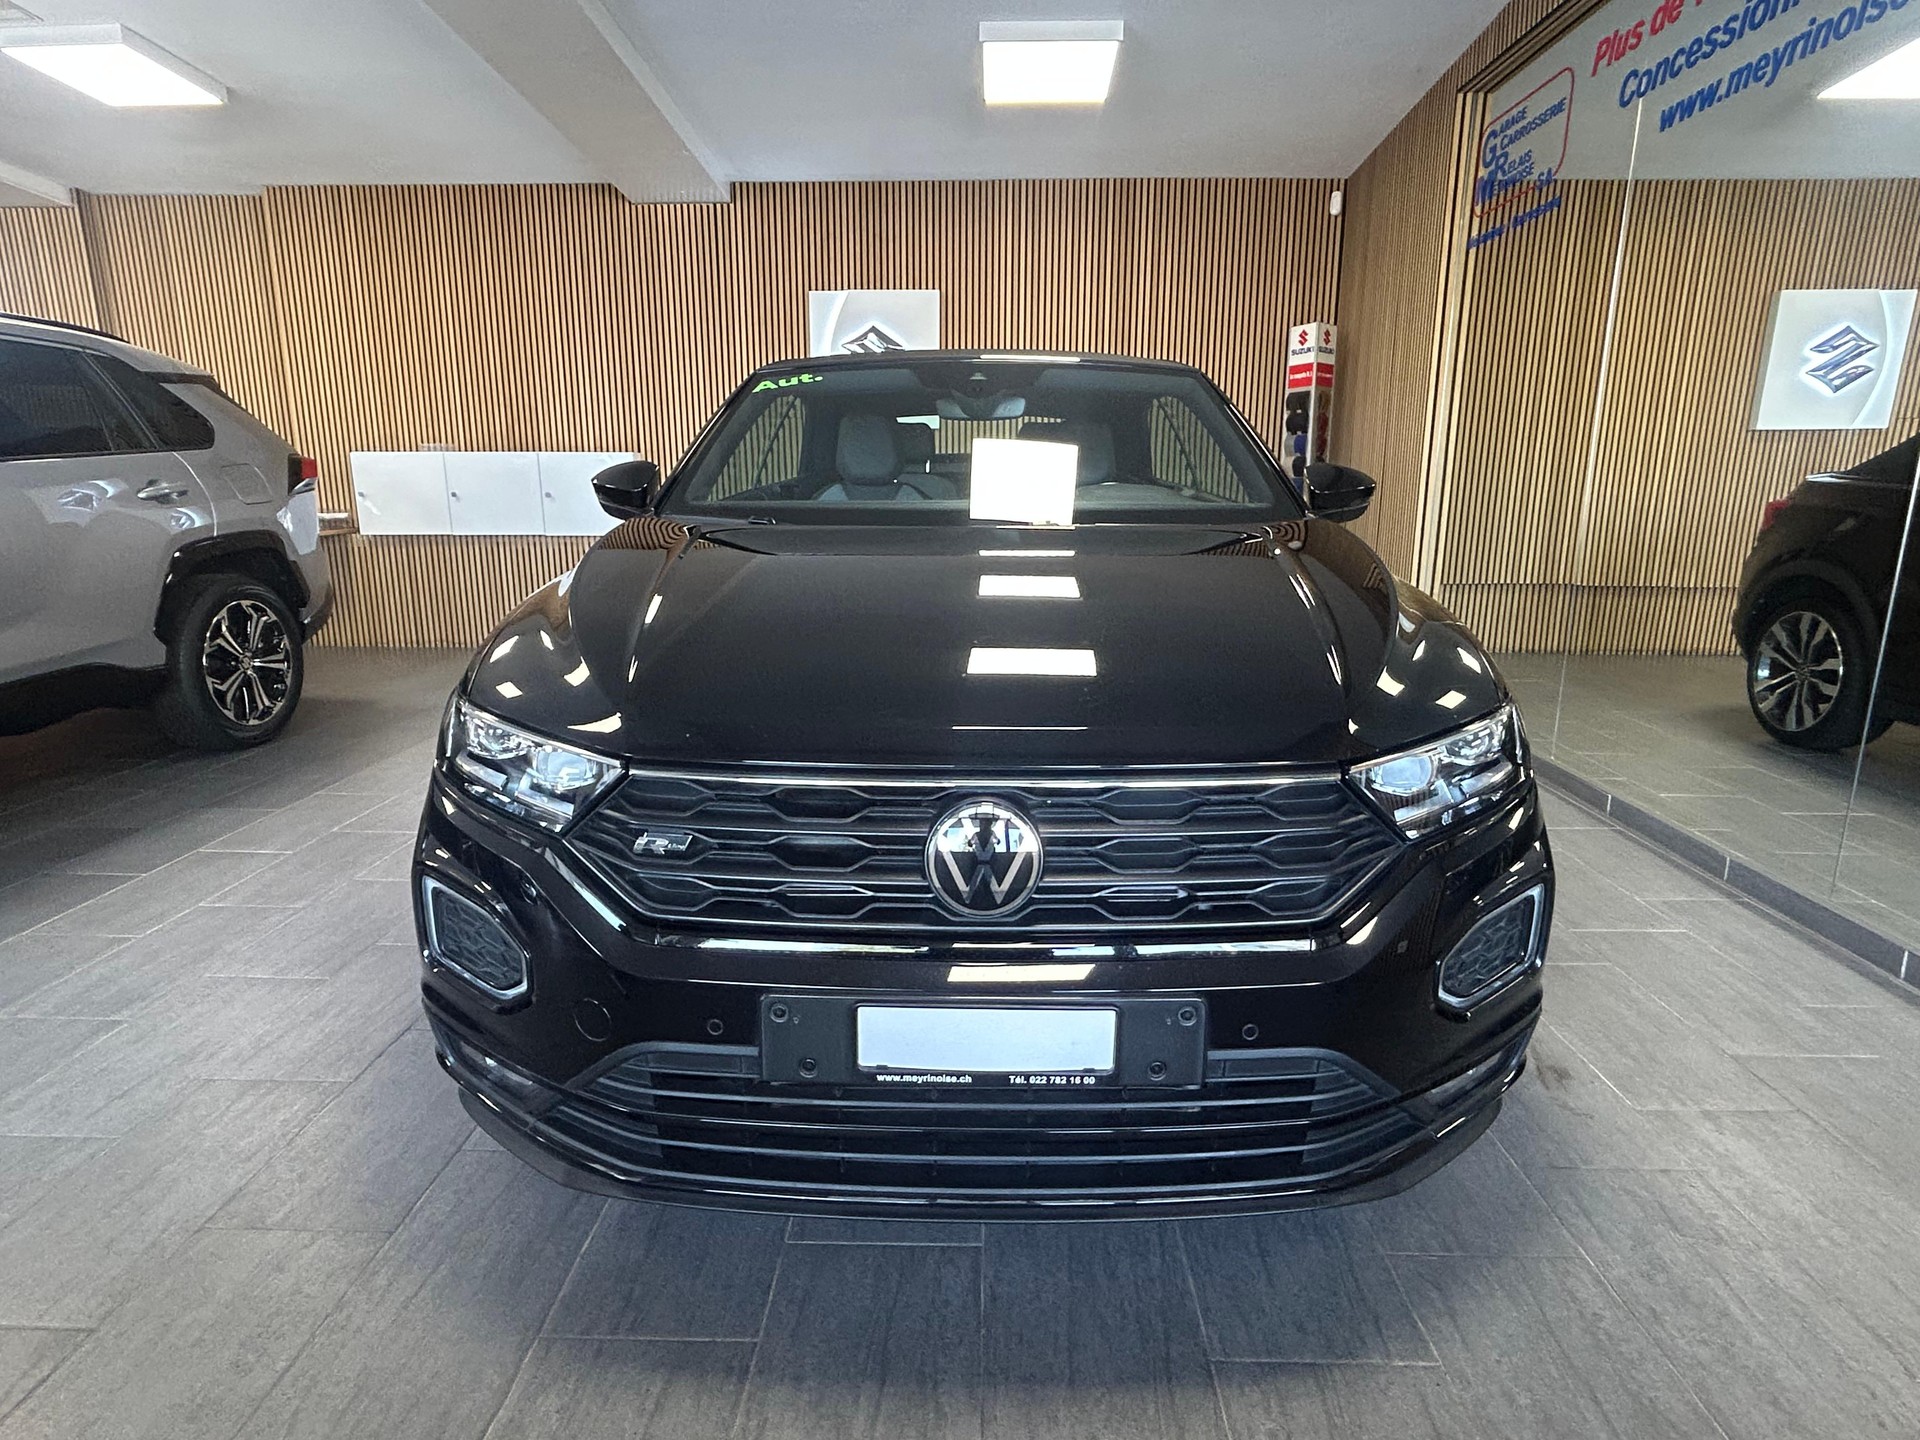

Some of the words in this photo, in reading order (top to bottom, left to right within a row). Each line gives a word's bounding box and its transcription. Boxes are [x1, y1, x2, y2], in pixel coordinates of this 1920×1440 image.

[1591, 20, 1645, 77] Plus
[1619, 0, 1800, 108] Concession
[1500, 97, 1567, 150] CARROSSERIE
[1291, 346, 1315, 356] SUZUKI
[752, 373, 823, 393] Aut.
[876, 1073, 972, 1084] www.meyrinoise.ch
[1029, 1076, 1047, 1084] 022
[1049, 1076, 1067, 1085] 782
[1069, 1076, 1081, 1085] 16
[1083, 1076, 1096, 1085] 00
